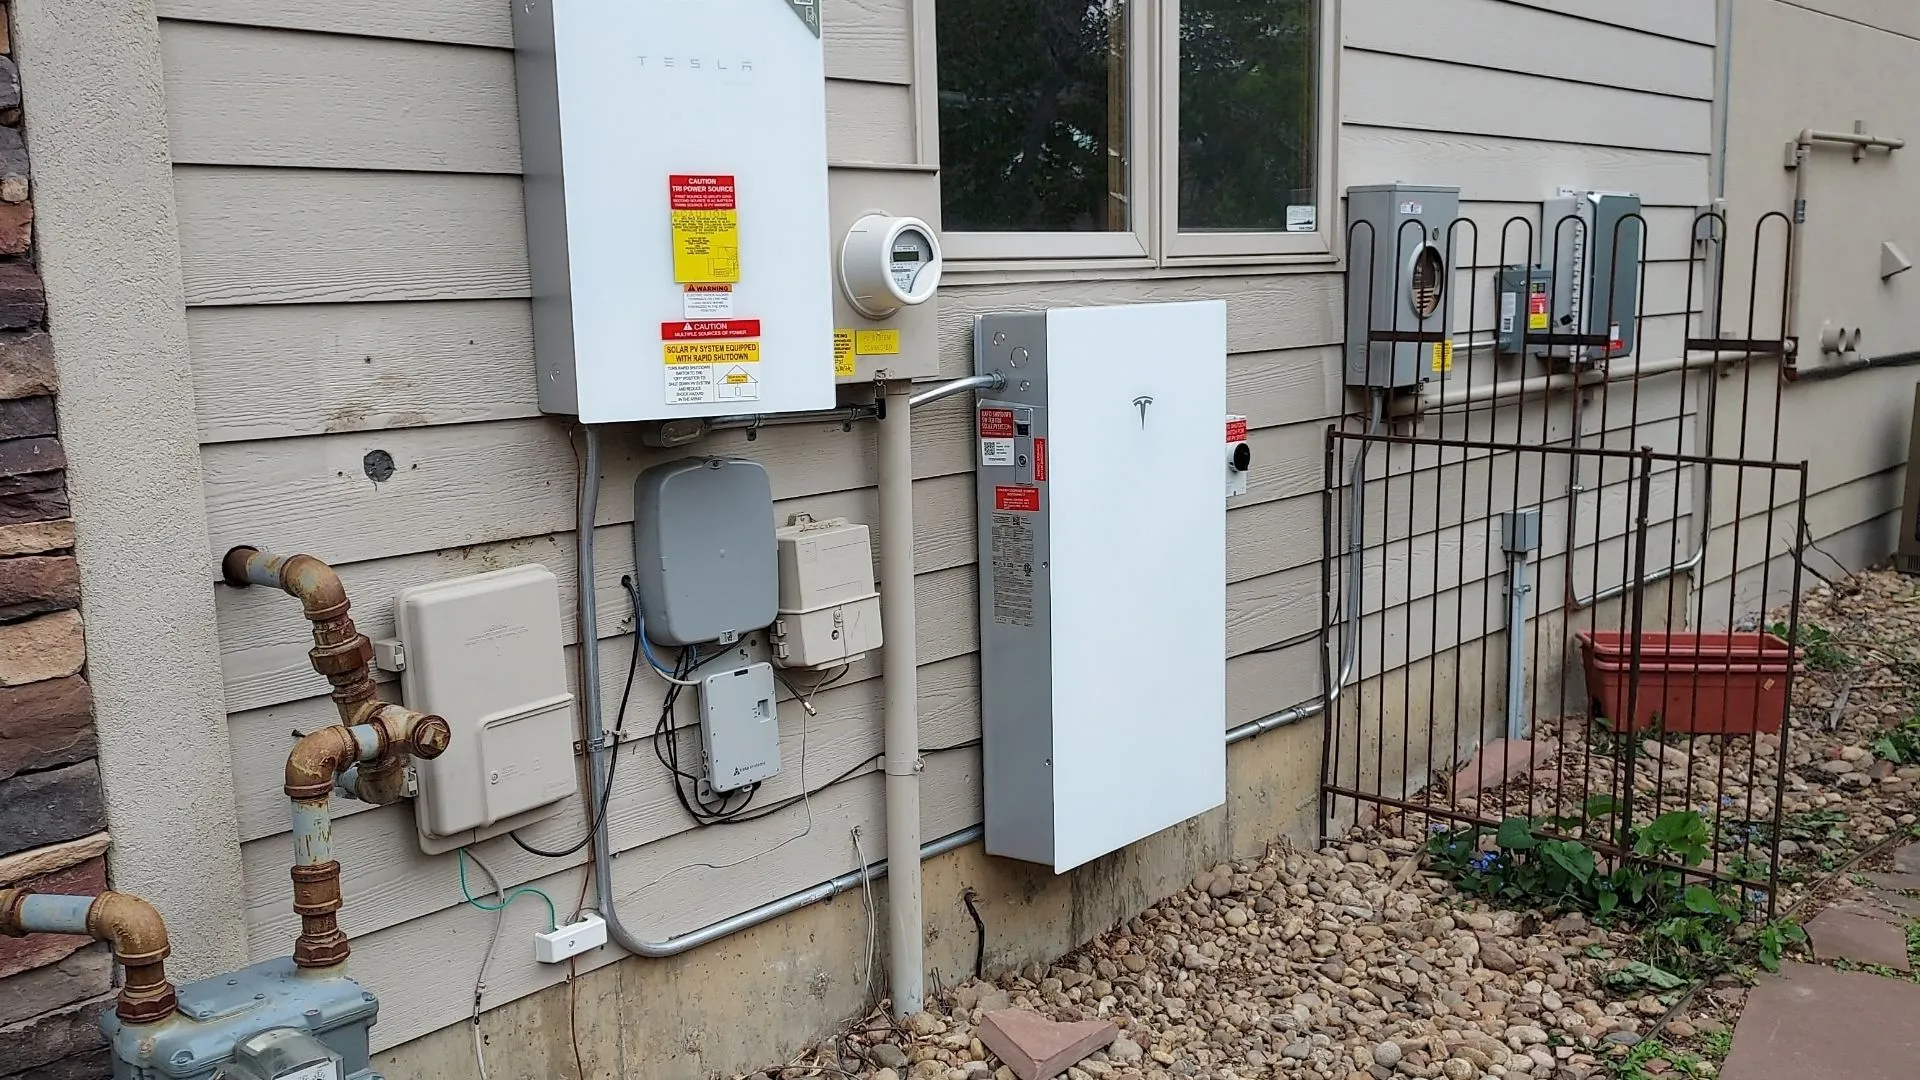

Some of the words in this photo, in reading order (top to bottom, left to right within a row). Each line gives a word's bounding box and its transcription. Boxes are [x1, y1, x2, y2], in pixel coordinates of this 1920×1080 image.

[638, 56, 752, 71] TESLA
[694, 322, 728, 331] CAUTION
[873, 333, 892, 341] SYSTEM
[666, 345, 689, 354] SOLAR
[699, 344, 724, 352] SYSTEM
[726, 343, 756, 352] EQUIPPED
[864, 343, 892, 352] CONNECTED
[676, 354, 692, 362] WITH
[693, 354, 712, 362] RAPID
[714, 353, 749, 361] SHUTDOWN
